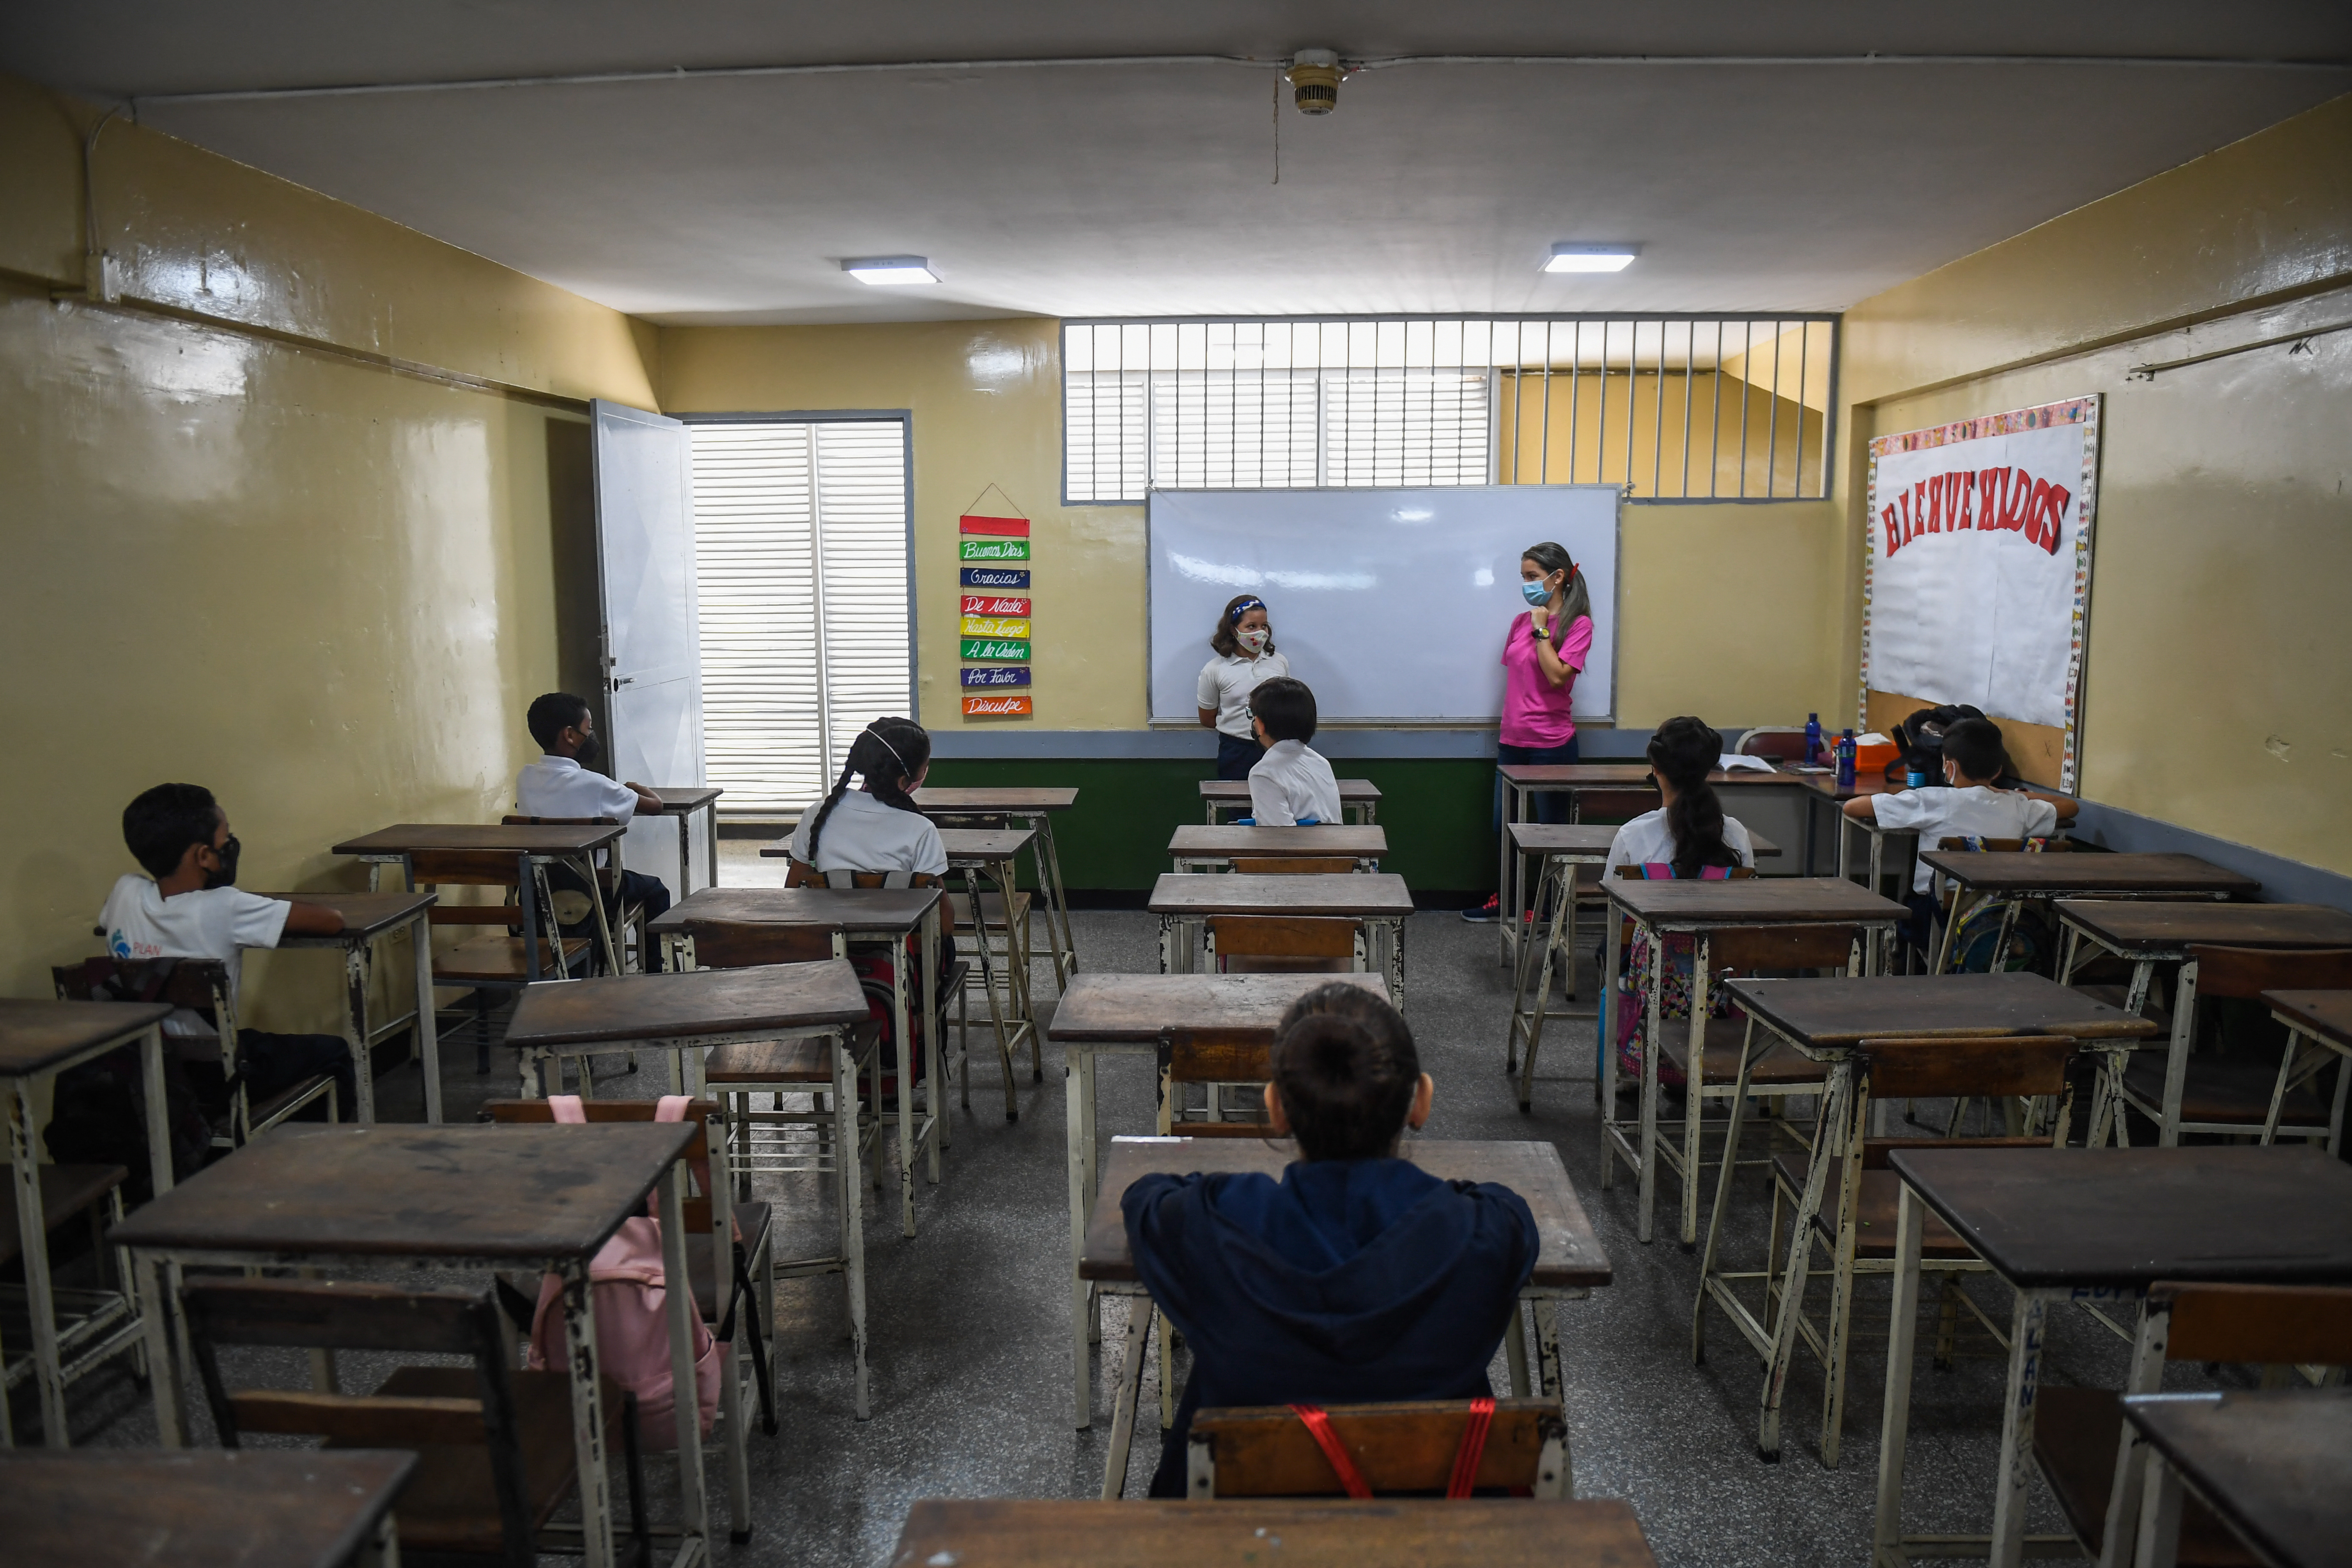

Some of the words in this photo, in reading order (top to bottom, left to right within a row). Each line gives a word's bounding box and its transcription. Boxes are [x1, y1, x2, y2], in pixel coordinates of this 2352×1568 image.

[1881, 466, 2071, 558] BIENVENIDOS
[964, 542, 1001, 558] Buenos
[971, 569, 1020, 584] Gracias
[965, 597, 984, 612] De
[988, 598, 1023, 612] Nada
[965, 620, 995, 634] Hasta
[995, 619, 1024, 637] Luego
[966, 642, 980, 657] A
[980, 642, 995, 657] la
[996, 642, 1024, 658] Orden
[968, 669, 986, 684] Por
[989, 668, 1017, 683] Favor
[967, 697, 1023, 714] Disculpe
